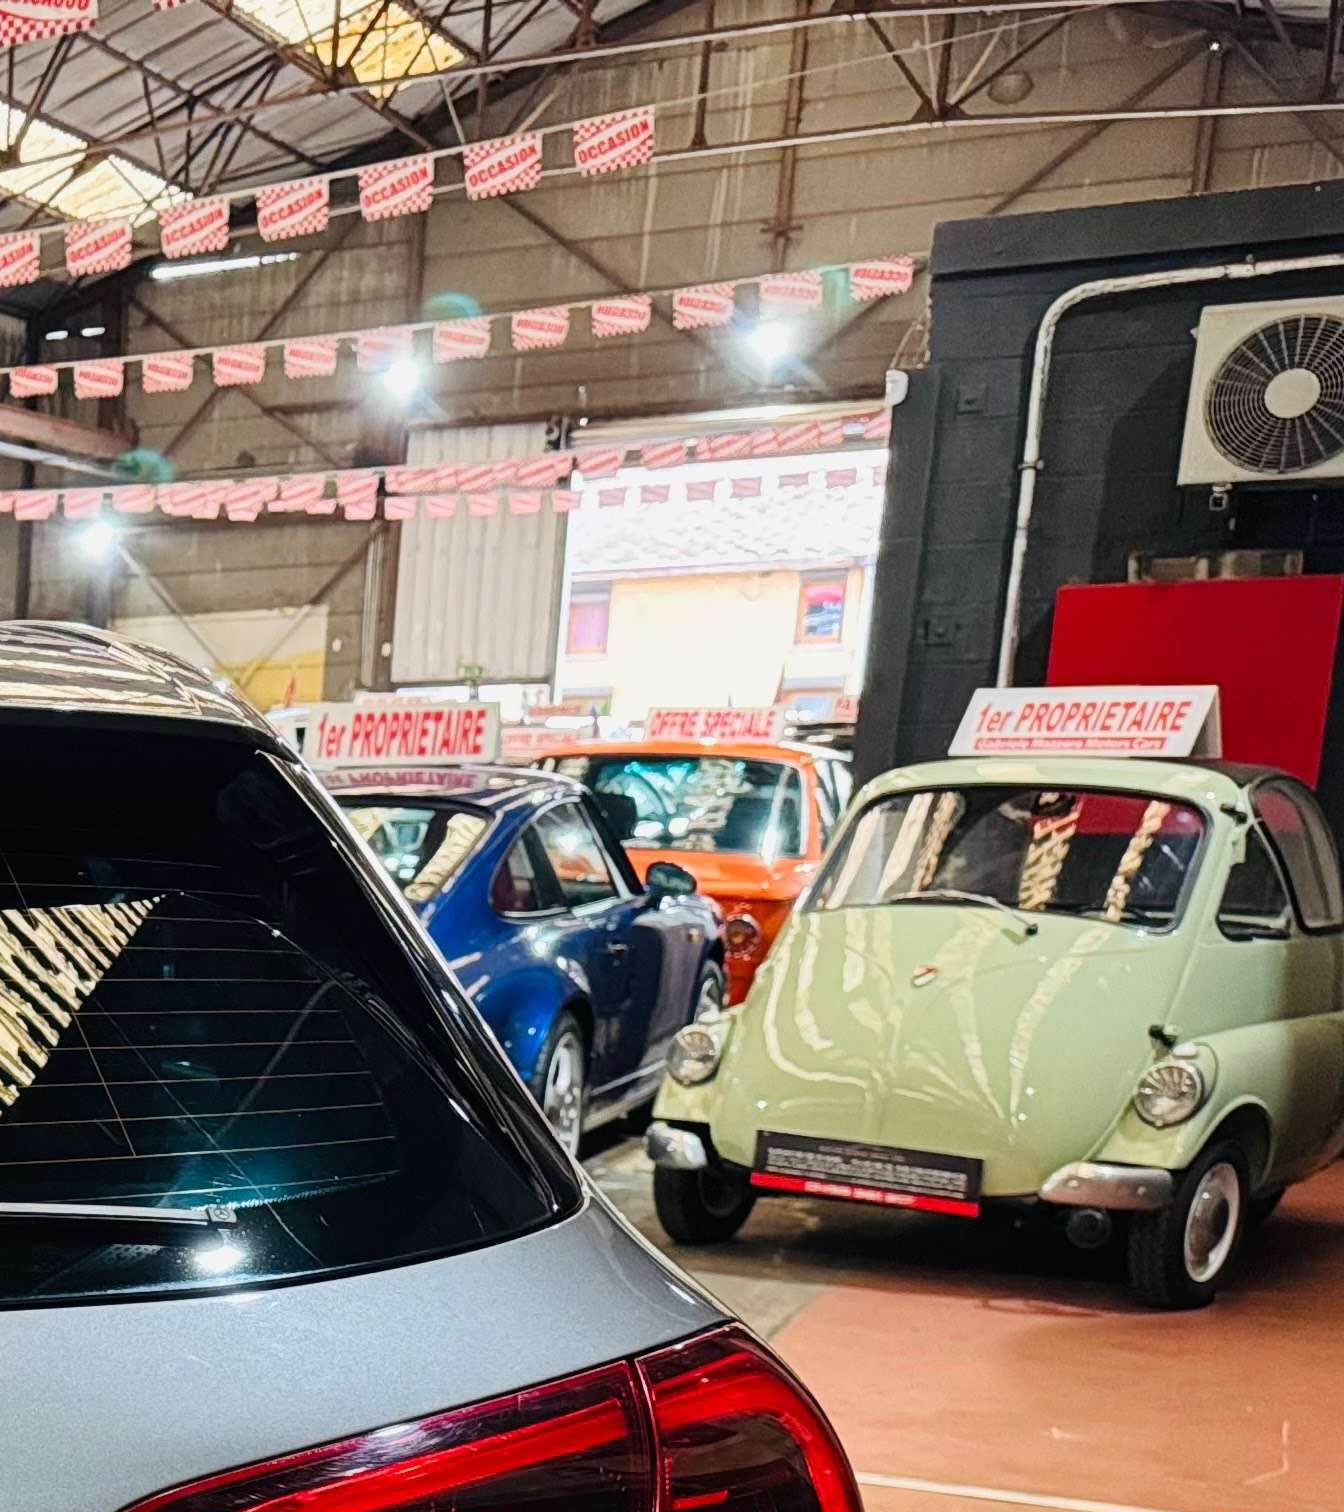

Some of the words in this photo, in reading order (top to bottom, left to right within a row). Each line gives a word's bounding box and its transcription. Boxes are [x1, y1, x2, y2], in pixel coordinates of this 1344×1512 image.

[579, 118, 649, 164] OCCASION
[469, 144, 536, 189] OCCASION
[364, 167, 428, 208] OCCASION
[262, 189, 322, 229] OCCASION
[317, 712, 347, 758] 1er
[348, 708, 487, 758] PROPRIETAIRE
[650, 710, 699, 738] OFFRE
[703, 709, 775, 739] SPECIALE
[976, 703, 1013, 733] 1er
[1013, 700, 1192, 732] PROPRIETAIRE
